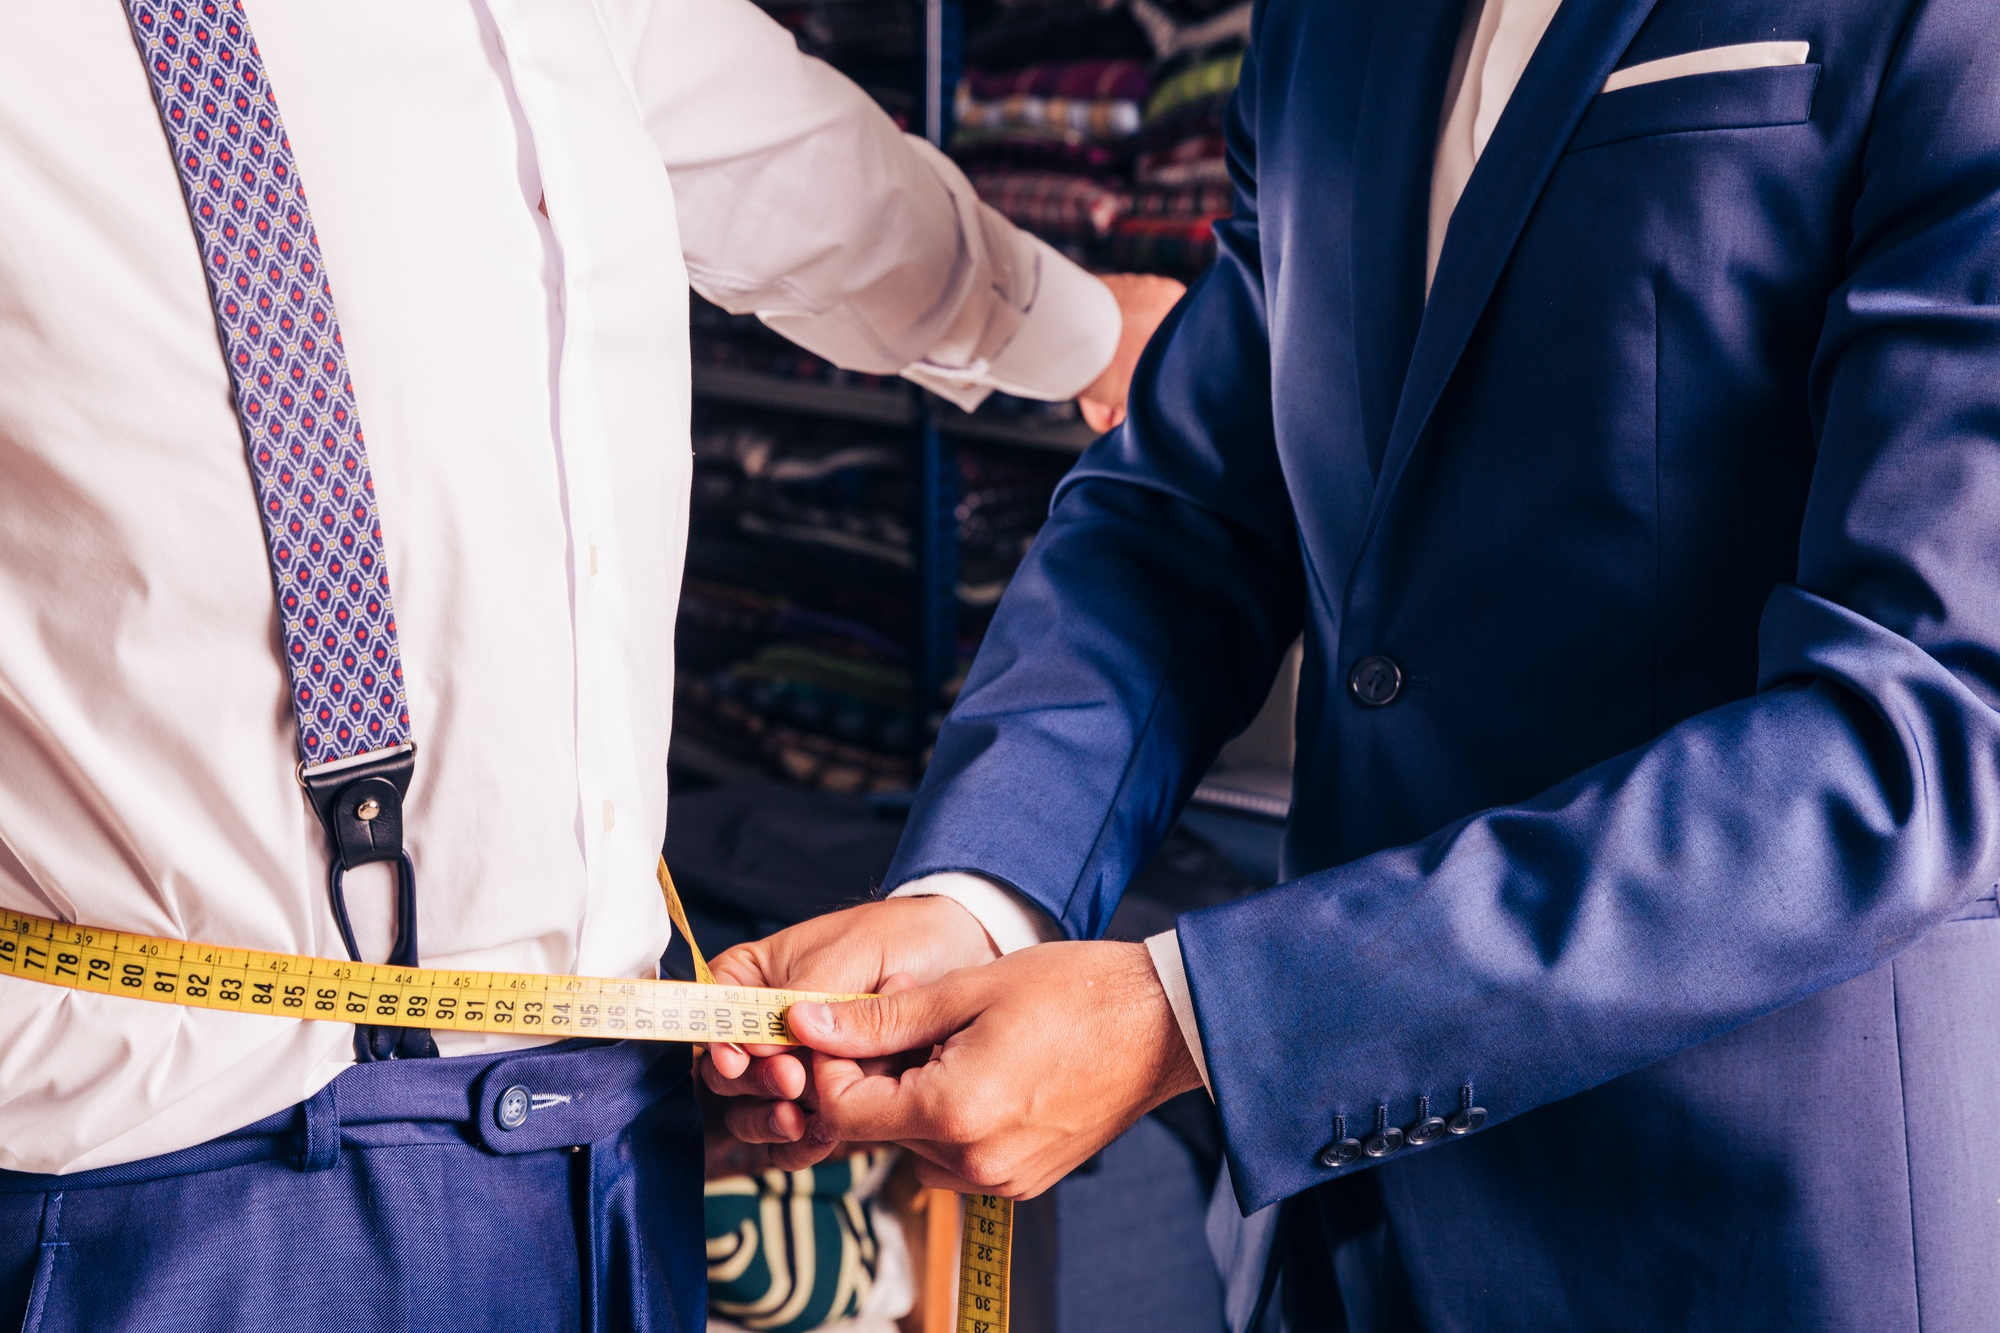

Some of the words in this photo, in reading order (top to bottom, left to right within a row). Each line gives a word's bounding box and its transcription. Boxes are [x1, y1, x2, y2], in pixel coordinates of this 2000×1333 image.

[12, 920, 29, 933] 38
[74, 933, 93, 946] 39
[140, 945, 158, 956] 40
[205, 954, 222, 965] 41
[270, 961, 289, 972] 42
[334, 968, 351, 980] 43
[395, 974, 412, 984] 44
[454, 978, 470, 988] 45
[510, 980, 527, 989] 46
[567, 982, 582, 991] 47
[620, 985, 636, 995] 48
[673, 987, 688, 999] 49
[724, 991, 739, 1001] 50
[775, 994, 787, 1005] 51
[24, 946, 47, 969] 77
[55, 953, 78, 975] 78
[87, 959, 110, 981] 79
[121, 964, 145, 987] 80
[154, 971, 177, 993] 81
[187, 974, 210, 997] 82
[219, 978, 242, 1001] 83
[251, 983, 274, 1004] 84
[283, 986, 305, 1008] 85
[315, 989, 337, 1011] 86
[346, 991, 368, 1013] 87
[376, 994, 398, 1015] 88
[407, 996, 428, 1017] 89
[436, 998, 457, 1019] 90
[465, 1001, 486, 1021] 91
[494, 1000, 515, 1023] 92
[523, 1002, 543, 1024] 93
[551, 1003, 571, 1025] 94
[580, 1004, 599, 1028] 95
[608, 1005, 626, 1029] 96
[635, 1007, 653, 1029] 97
[662, 1008, 680, 1031] 98
[689, 1009, 707, 1032] 99
[716, 1008, 733, 1037] 100
[742, 1011, 761, 1038] 101
[766, 1011, 786, 1038] 102
[980, 1219, 995, 1235] 33
[977, 1246, 993, 1262] 32
[977, 1271, 992, 1287] 31
[975, 1297, 991, 1312] 30
